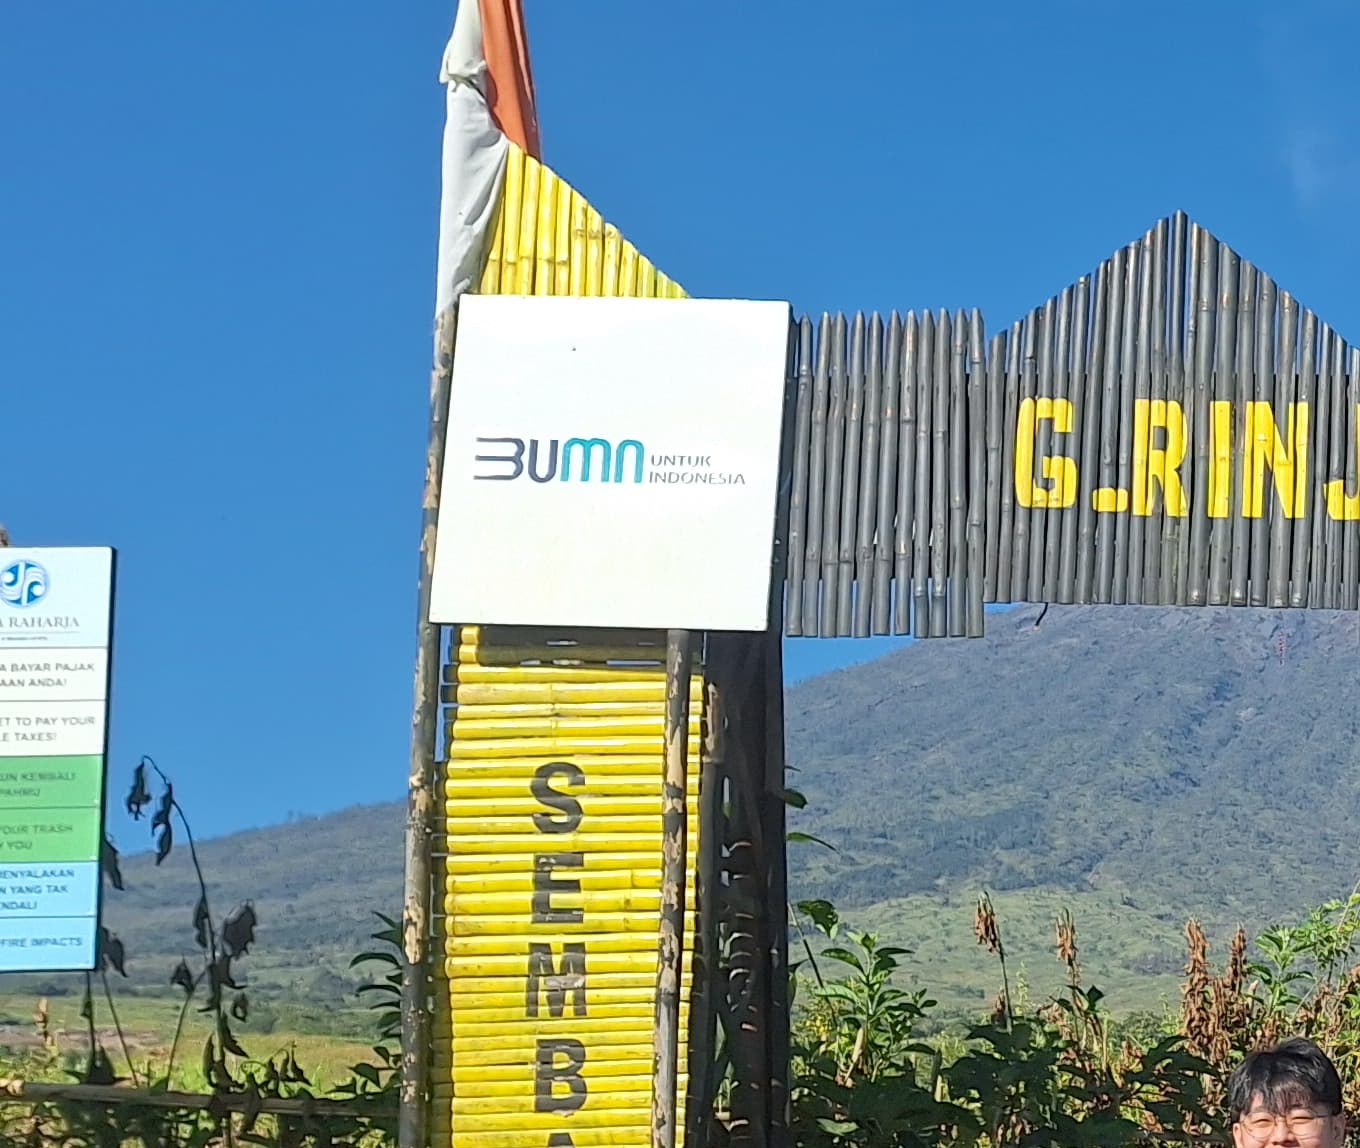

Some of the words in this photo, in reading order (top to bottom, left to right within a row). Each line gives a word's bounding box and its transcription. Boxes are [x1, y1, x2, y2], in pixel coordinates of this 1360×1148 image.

[651, 455, 711, 467] UNTUK
[649, 471, 746, 485] INDONESIA
[9, 616, 80, 628] RAHARJA
[11, 662, 51, 672] BAYAR
[55, 662, 95, 672] PAJAK
[15, 716, 31, 726] TO
[35, 716, 58, 726] PAY
[61, 716, 95, 726] YOUR
